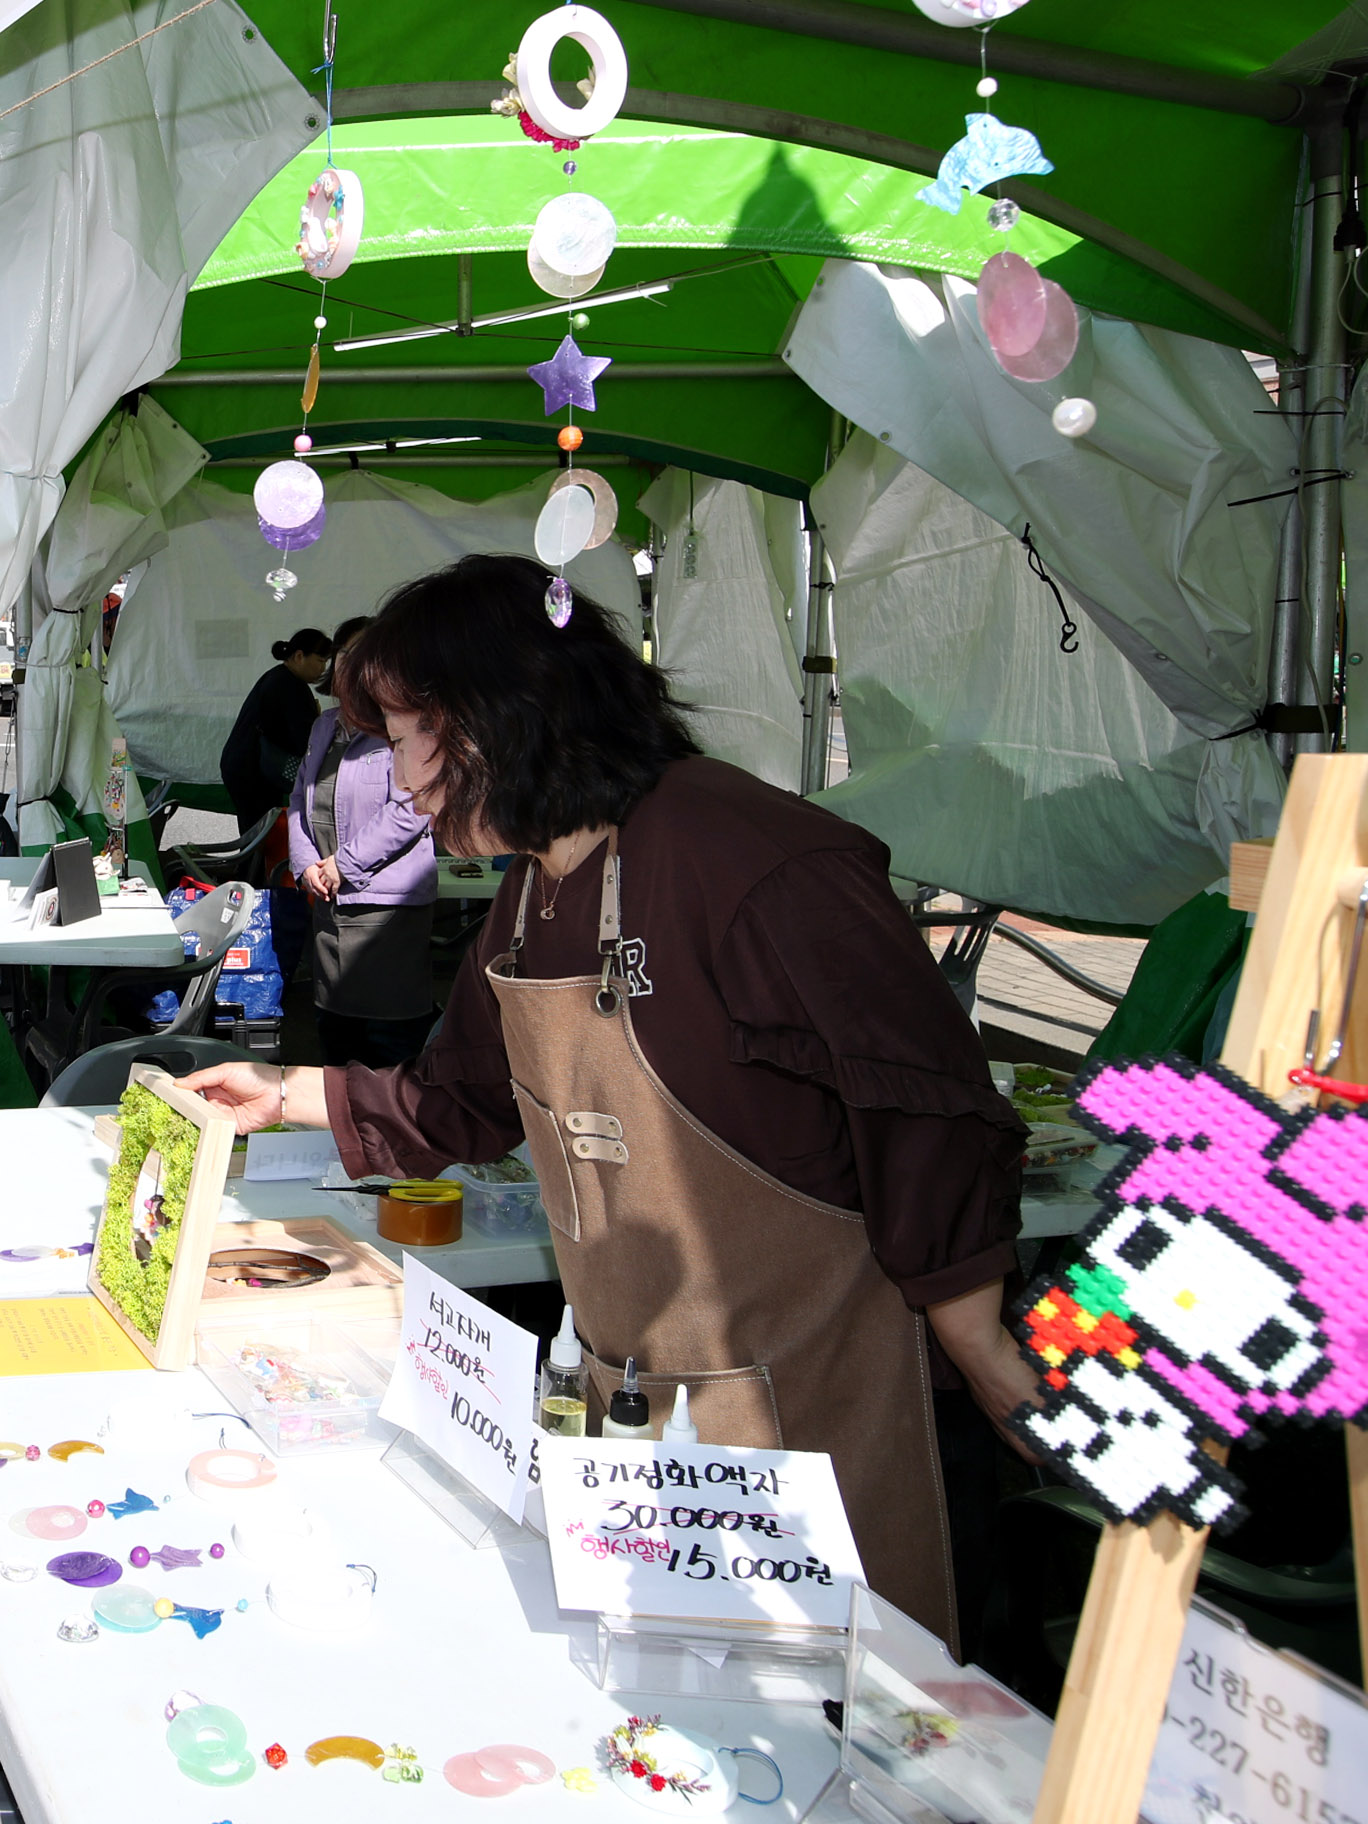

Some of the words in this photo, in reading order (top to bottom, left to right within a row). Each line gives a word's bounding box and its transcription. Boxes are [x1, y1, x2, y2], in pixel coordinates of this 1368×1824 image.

[451, 1391, 517, 1476] 10.000원
[581, 1534, 671, 1563] 행사할인
[666, 1543, 834, 1586] 15.000원
[600, 1499, 783, 1538] 30.000원
[1183, 1648, 1331, 1767] 신한은행
[1162, 1703, 1363, 1824] -227-615
